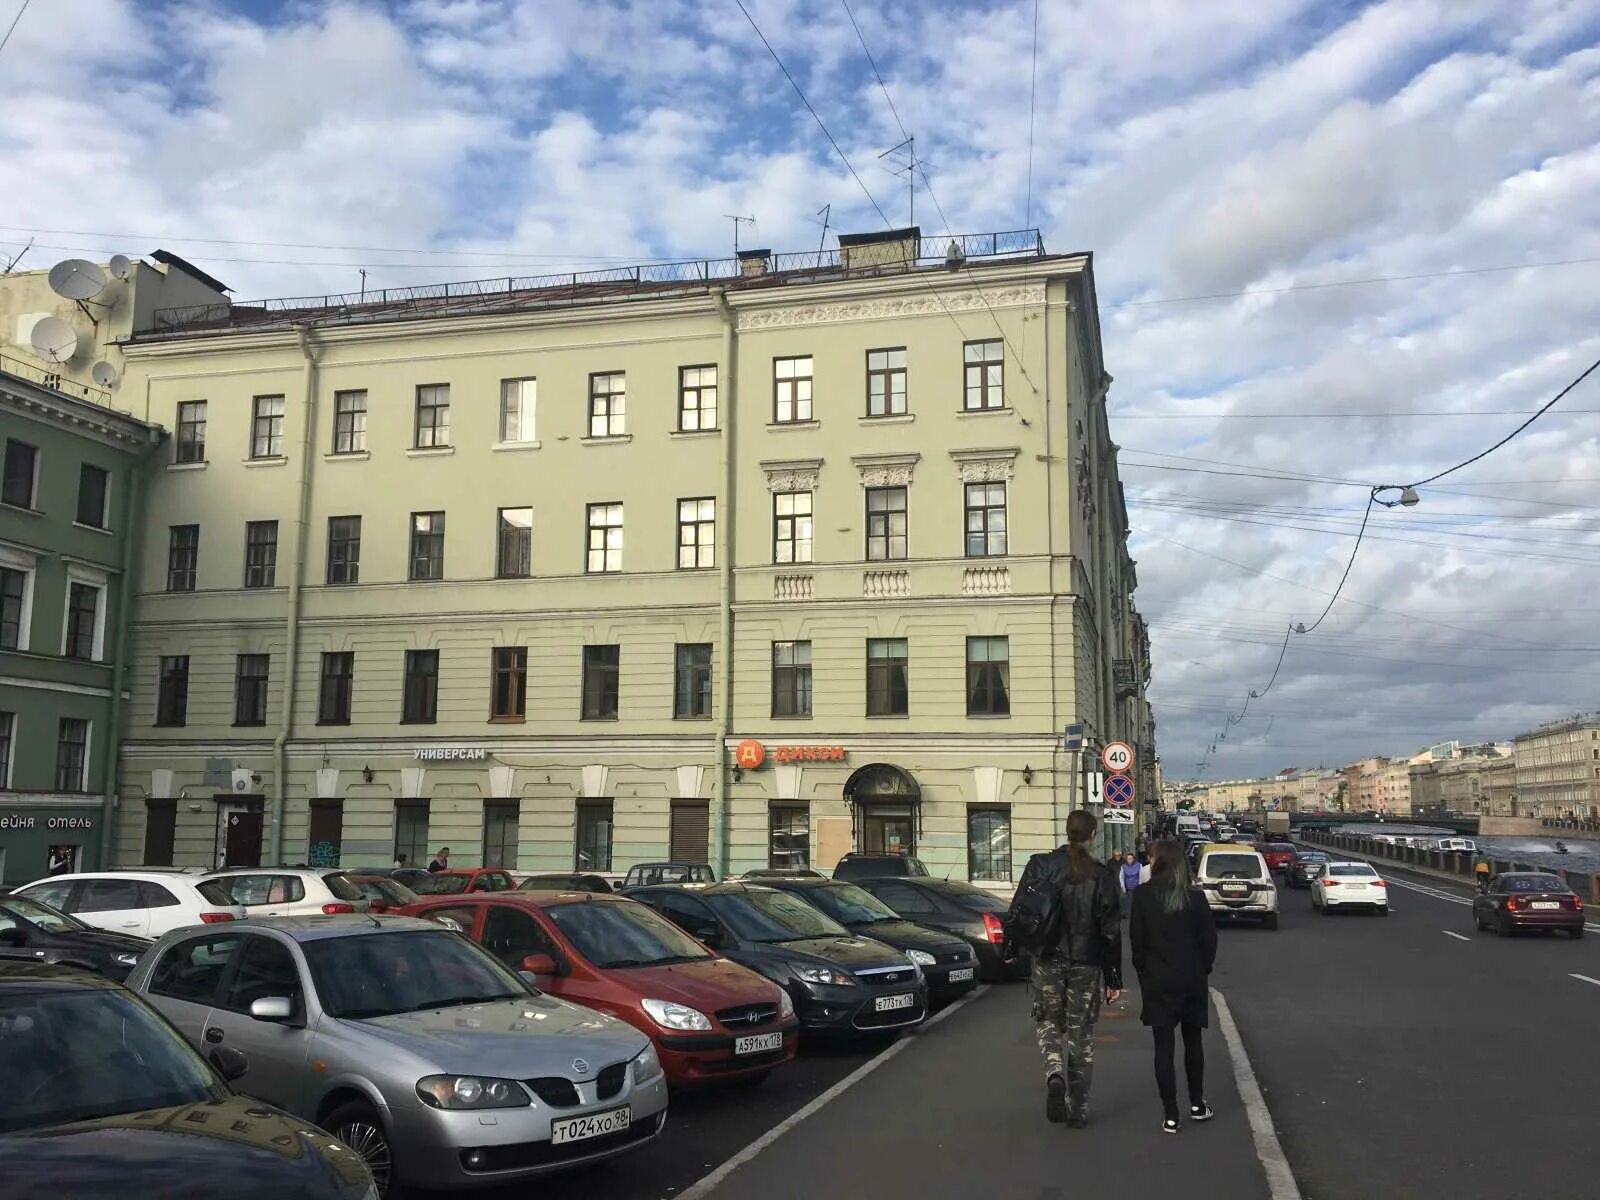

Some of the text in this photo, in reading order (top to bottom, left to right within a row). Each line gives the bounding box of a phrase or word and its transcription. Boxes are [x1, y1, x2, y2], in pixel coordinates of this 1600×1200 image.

[413, 748, 485, 760] УНИВЕРСАМ
[1109, 751, 1127, 763] 40
[48, 817, 92, 828] отель
